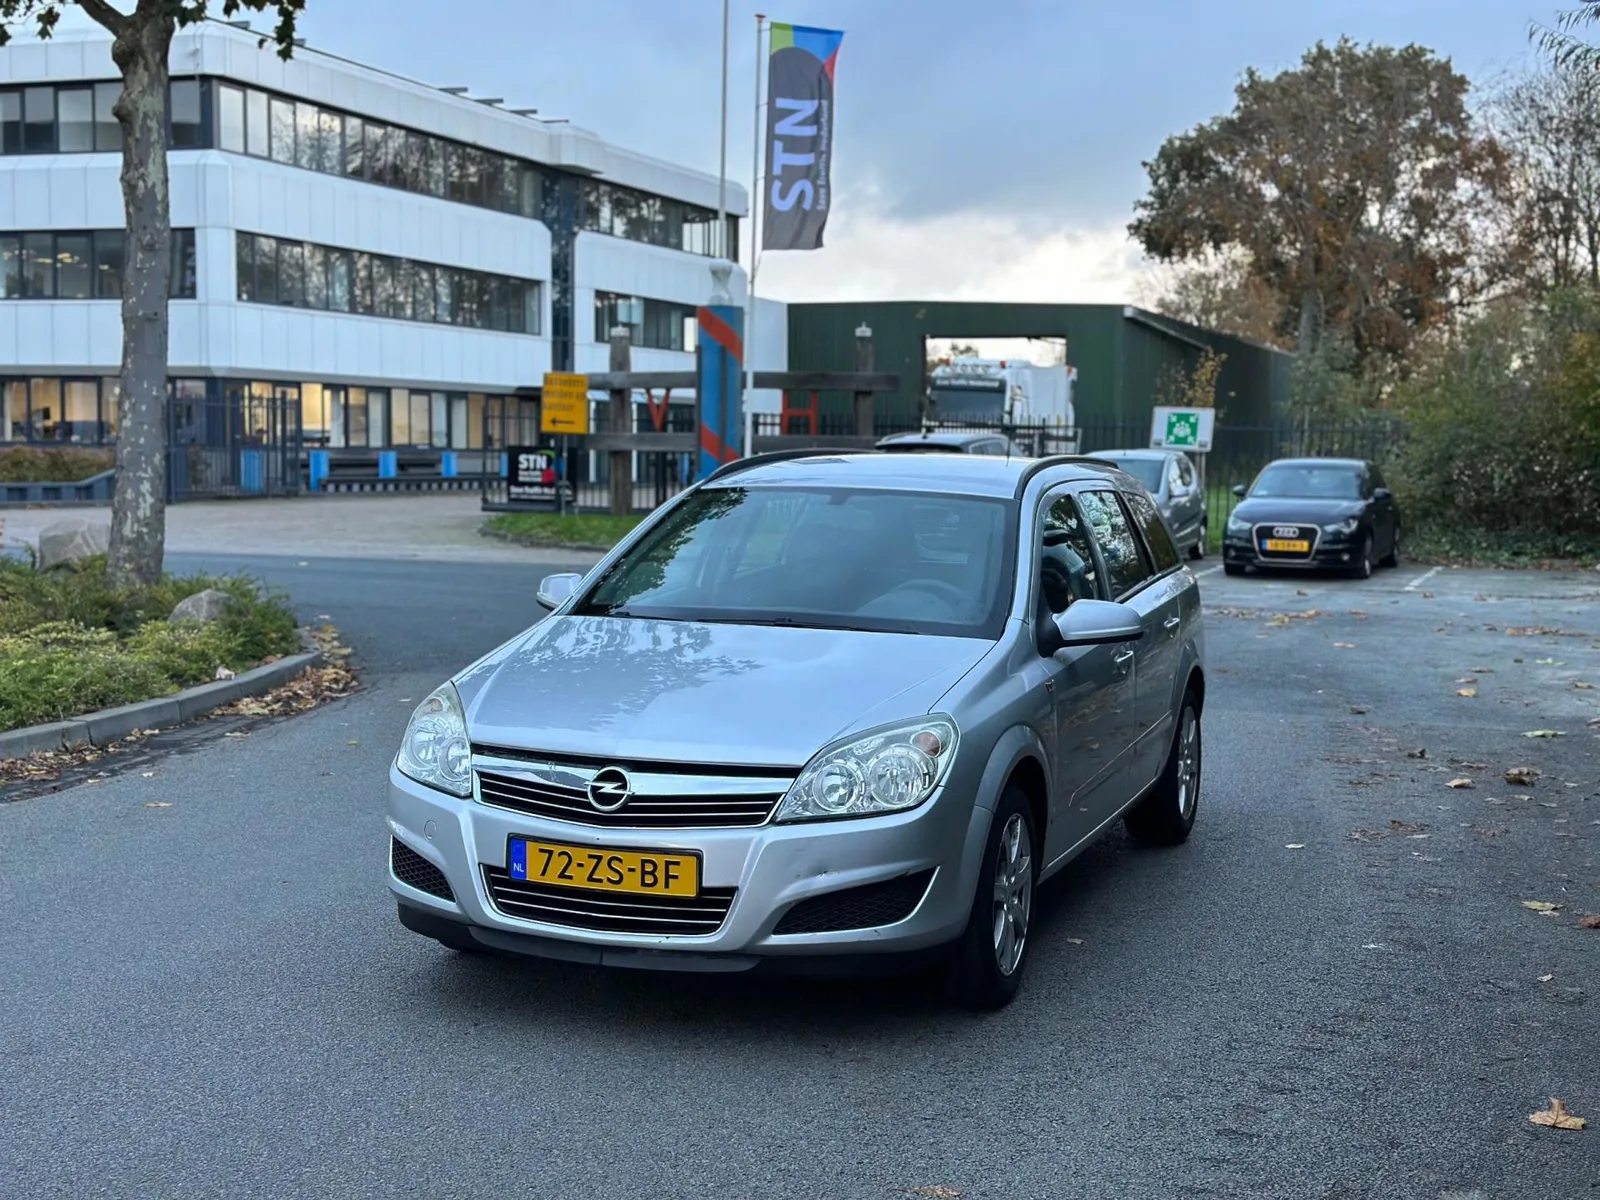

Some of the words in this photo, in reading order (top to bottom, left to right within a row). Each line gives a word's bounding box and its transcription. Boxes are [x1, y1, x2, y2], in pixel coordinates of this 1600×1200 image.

[771, 97, 819, 211] STN
[518, 453, 547, 469] STN
[513, 862, 525, 872] NL
[538, 848, 681, 889] 72-ZS-BF
